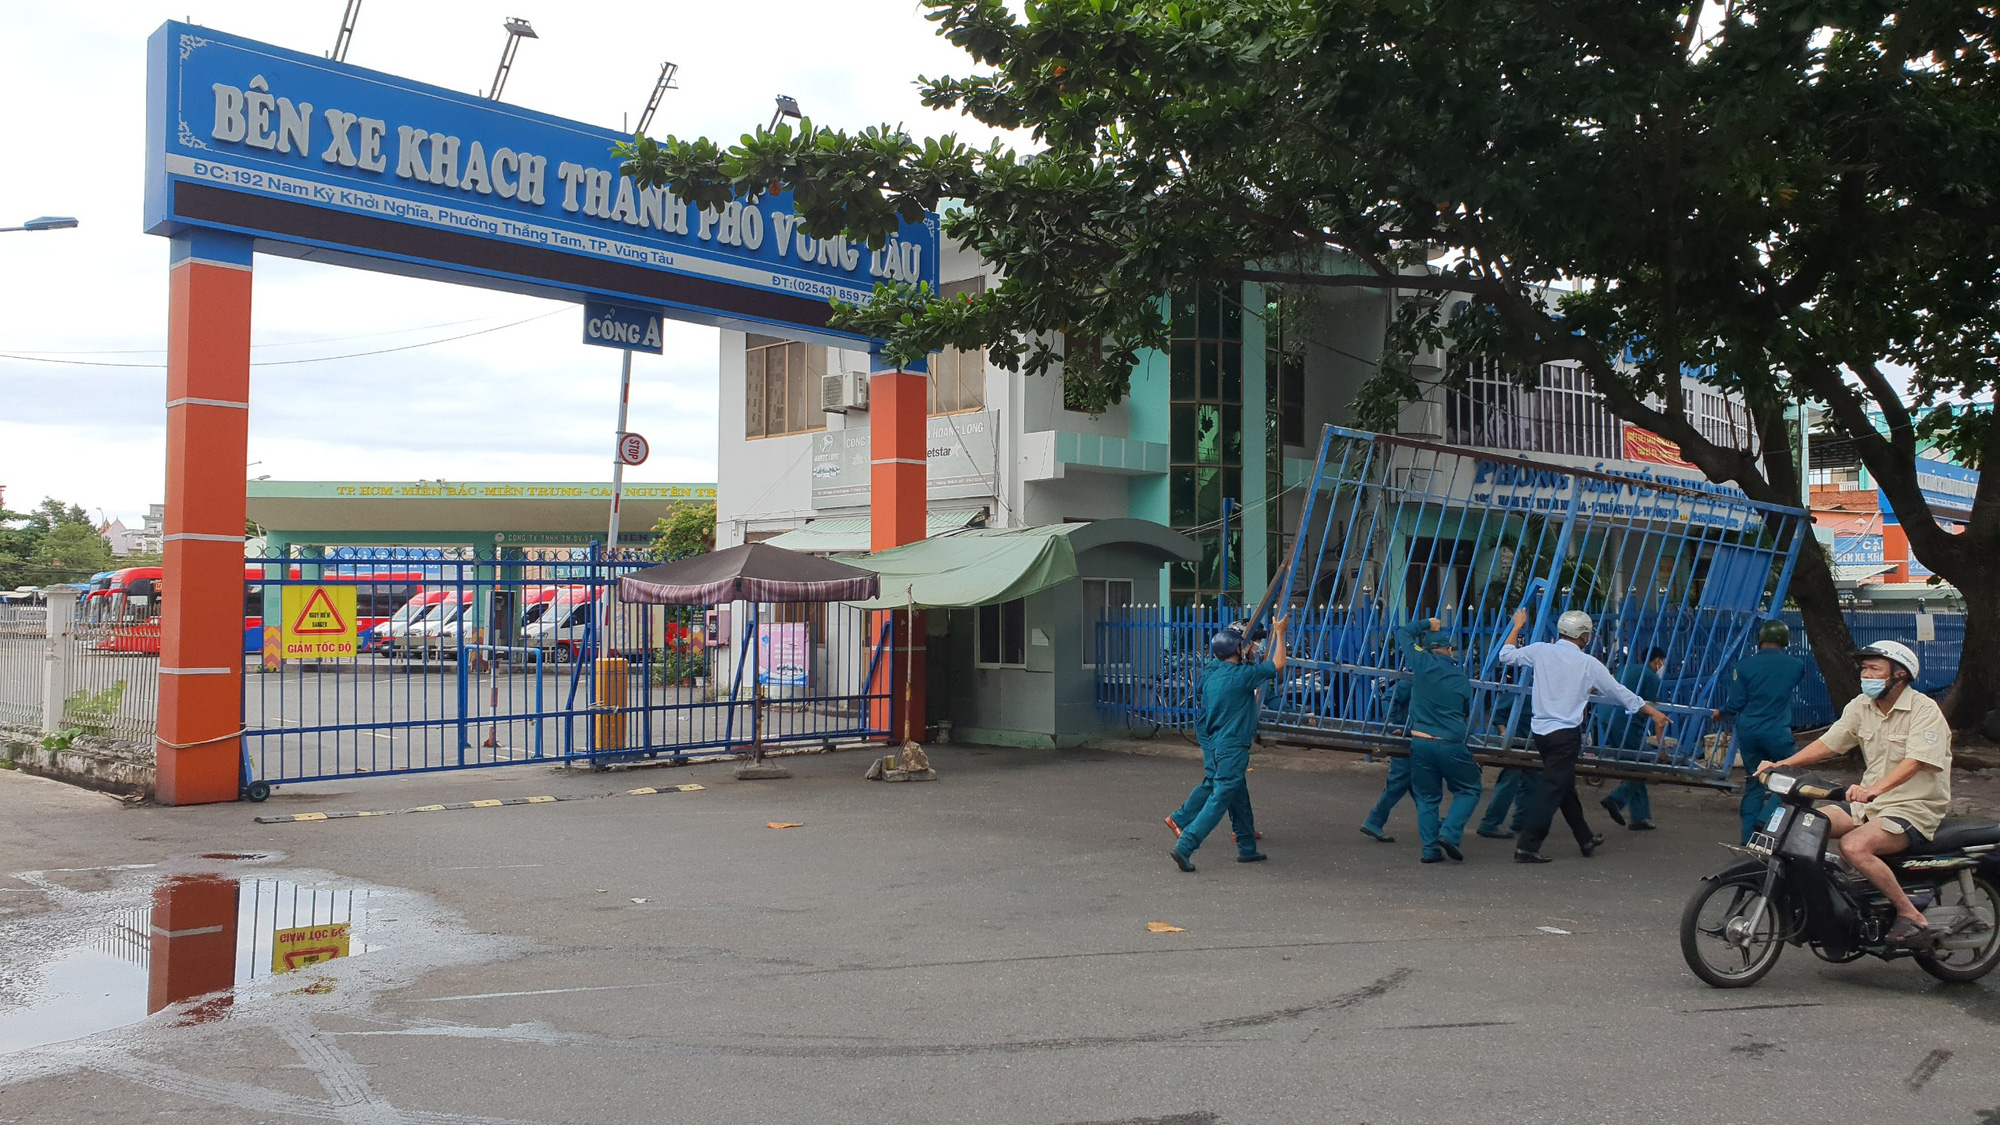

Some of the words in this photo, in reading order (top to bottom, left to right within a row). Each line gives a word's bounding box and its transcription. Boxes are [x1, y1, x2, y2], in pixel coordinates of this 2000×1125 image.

[321, 109, 387, 173] XE
[268, 176, 309, 196] Nam
[314, 186, 335, 203] Kỳ
[340, 191, 379, 210] Khởi
[384, 199, 434, 221] Nghĩa,
[438, 209, 498, 234] Phường
[502, 222, 549, 243] Thắng
[552, 231, 586, 250] Tam,
[589, 238, 610, 253] TP.
[614, 244, 649, 262] Vũng
[651, 251, 674, 265] Tàu
[588, 308, 641, 344] CỔNG
[642, 316, 662, 347] A
[962, 422, 984, 435] LONG
[628, 438, 640, 460] STOP
[316, 641, 336, 653] TỐC
[338, 641, 352, 653] ĐỘ
